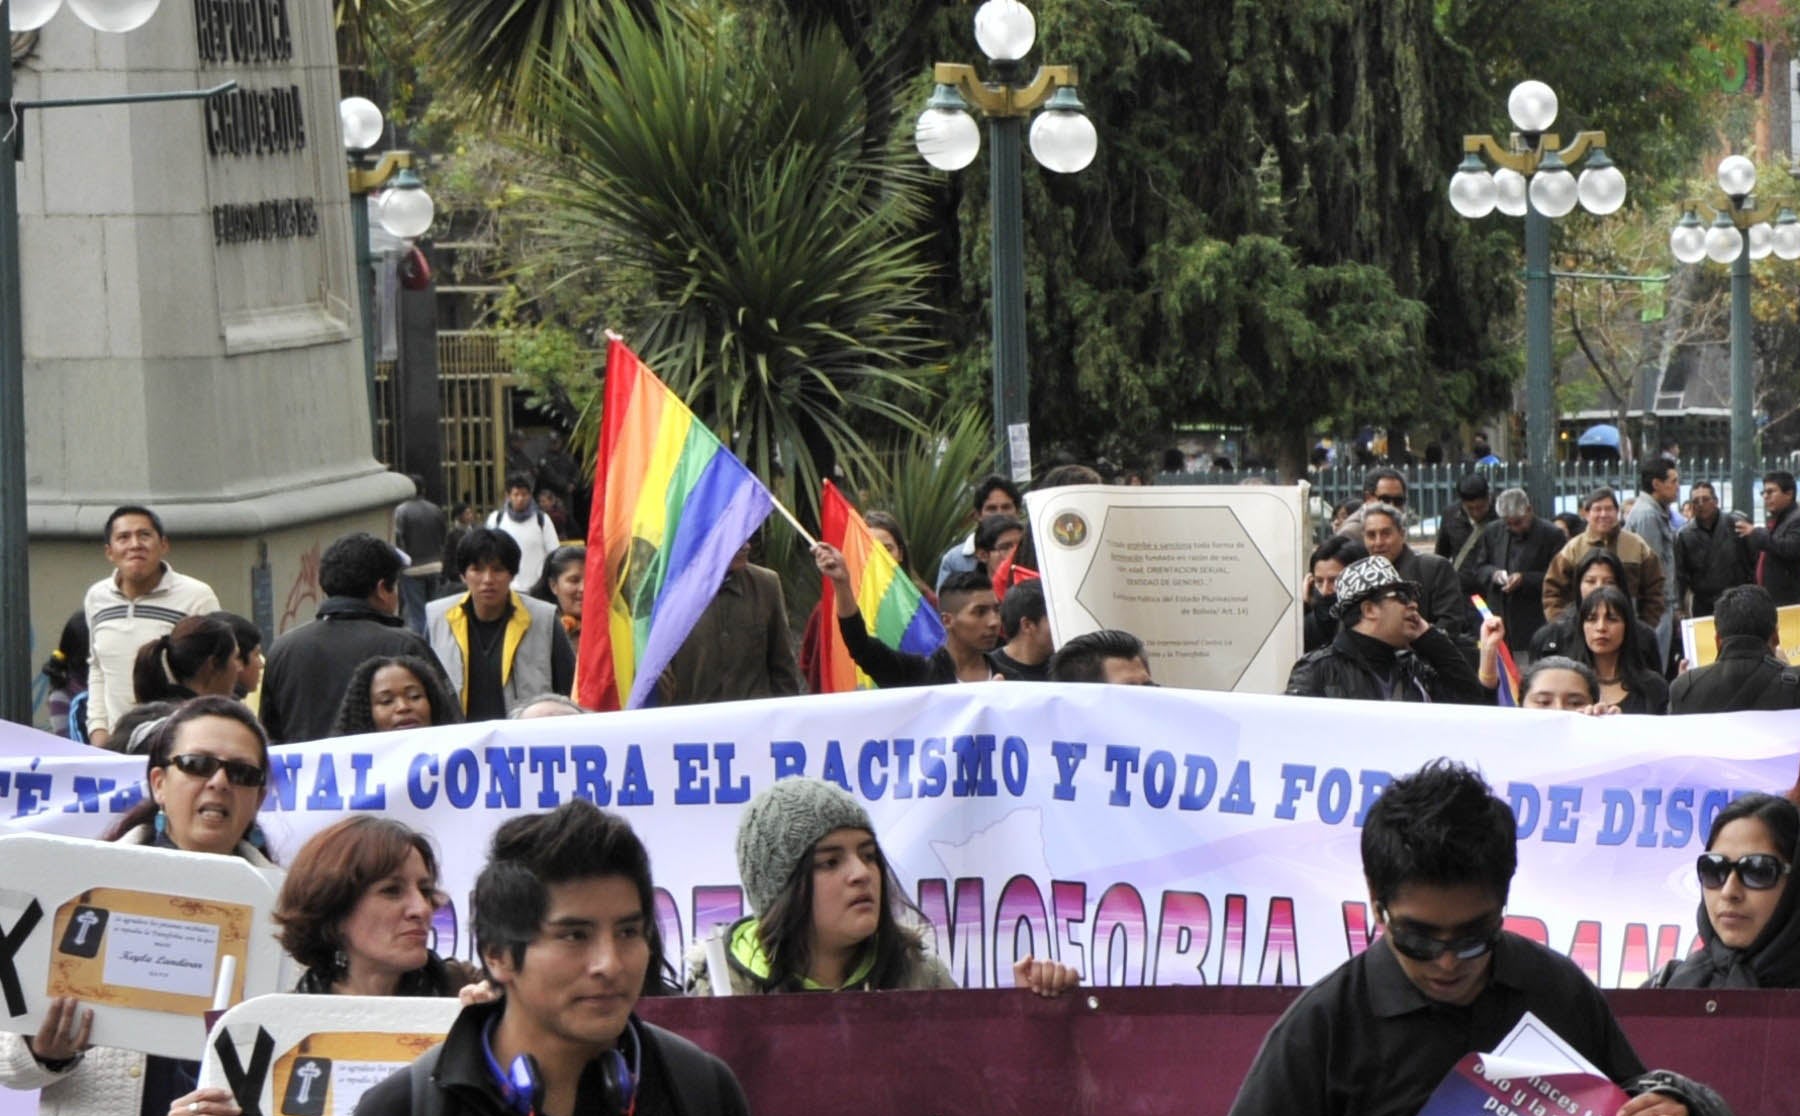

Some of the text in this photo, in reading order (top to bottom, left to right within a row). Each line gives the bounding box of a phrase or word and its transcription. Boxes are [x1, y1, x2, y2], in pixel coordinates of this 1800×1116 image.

[407, 743, 654, 810] CONTRA
[673, 741, 751, 805] EL
[1051, 741, 1087, 802] Y
[1104, 744, 1255, 816] TODA
[1506, 780, 1583, 844] DE
[917, 873, 1301, 988] MOFOBIA
[1513, 1089, 1527, 1106] y
